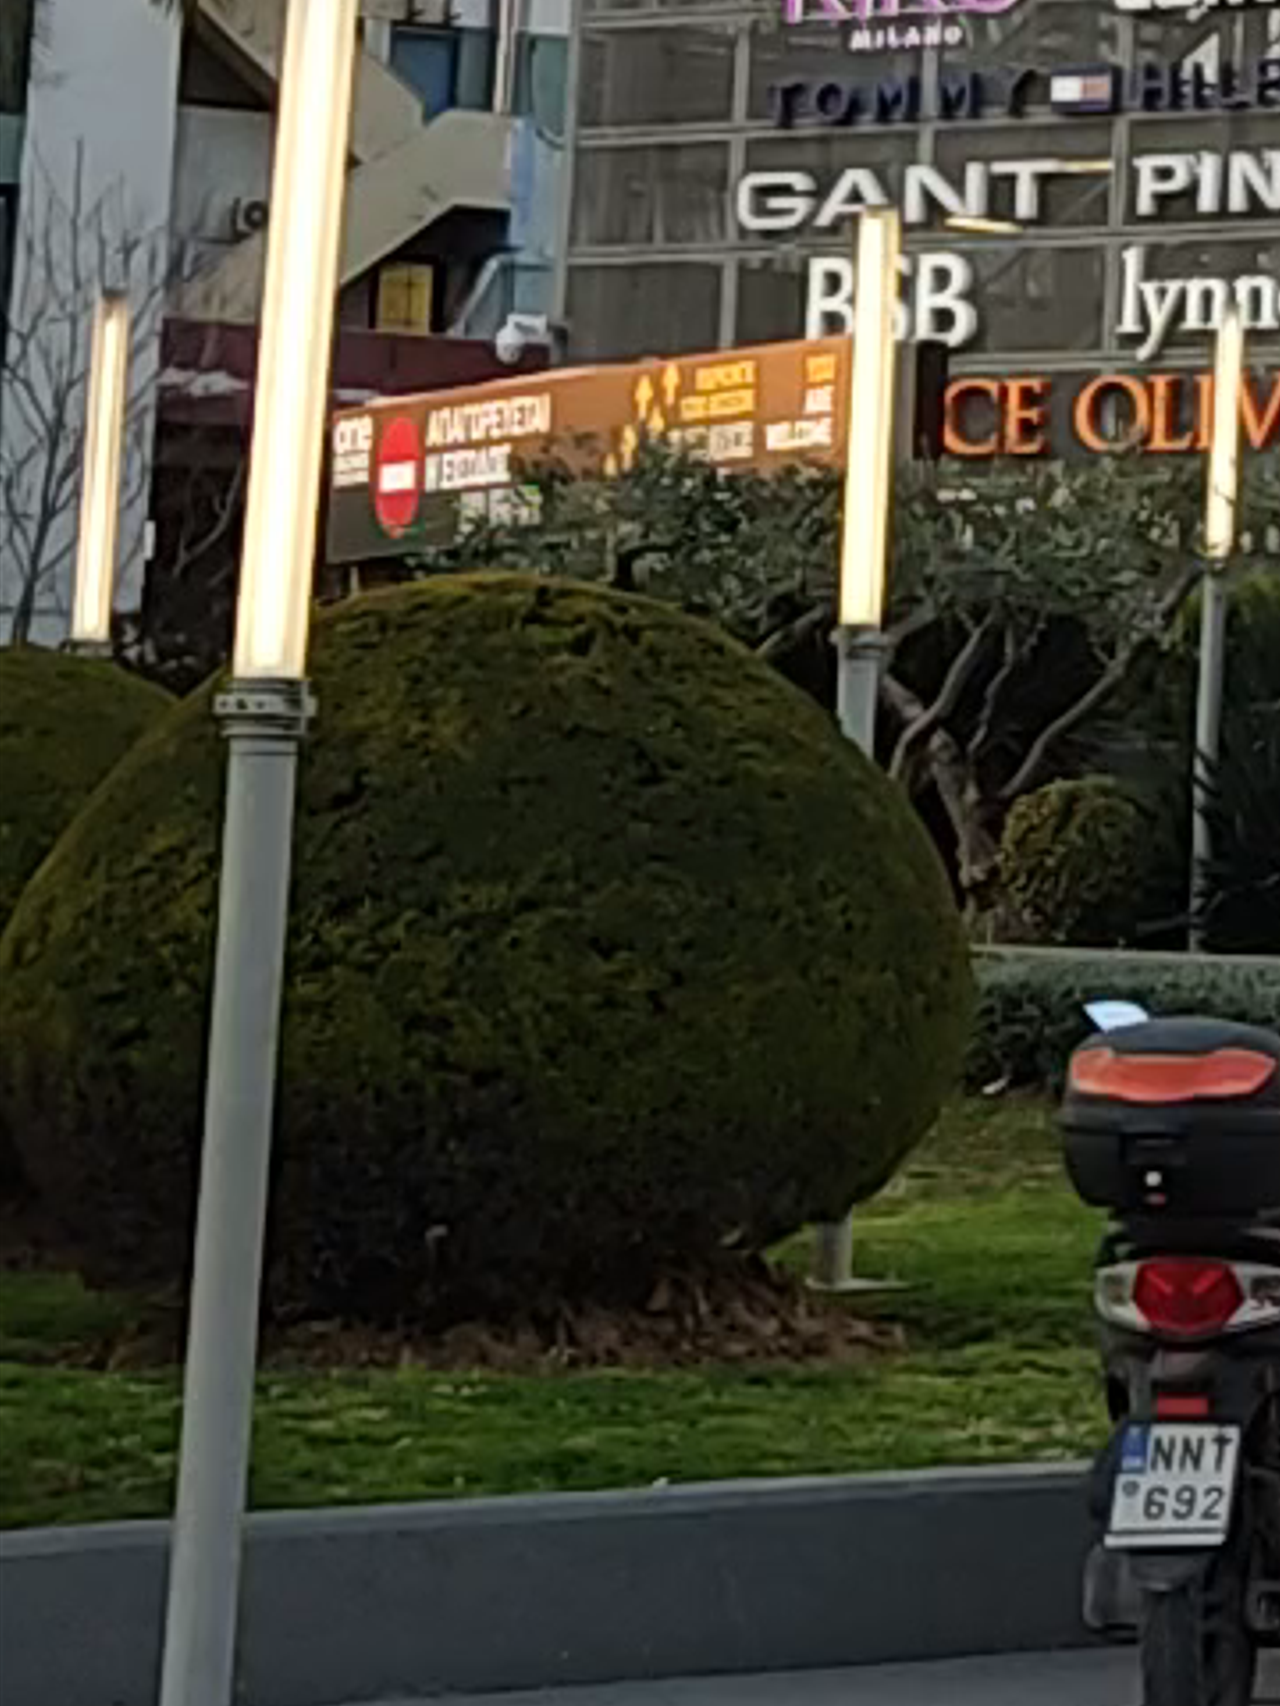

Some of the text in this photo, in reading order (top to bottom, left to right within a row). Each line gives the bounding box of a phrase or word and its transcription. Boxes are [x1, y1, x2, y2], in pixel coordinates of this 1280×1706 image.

[849, 24, 963, 53] MILANO
[773, 68, 1040, 128] TOMMY
[737, 158, 1062, 231] GANT
[1150, 1435, 1234, 1473] NNT
[1142, 1484, 1225, 1522] 692
